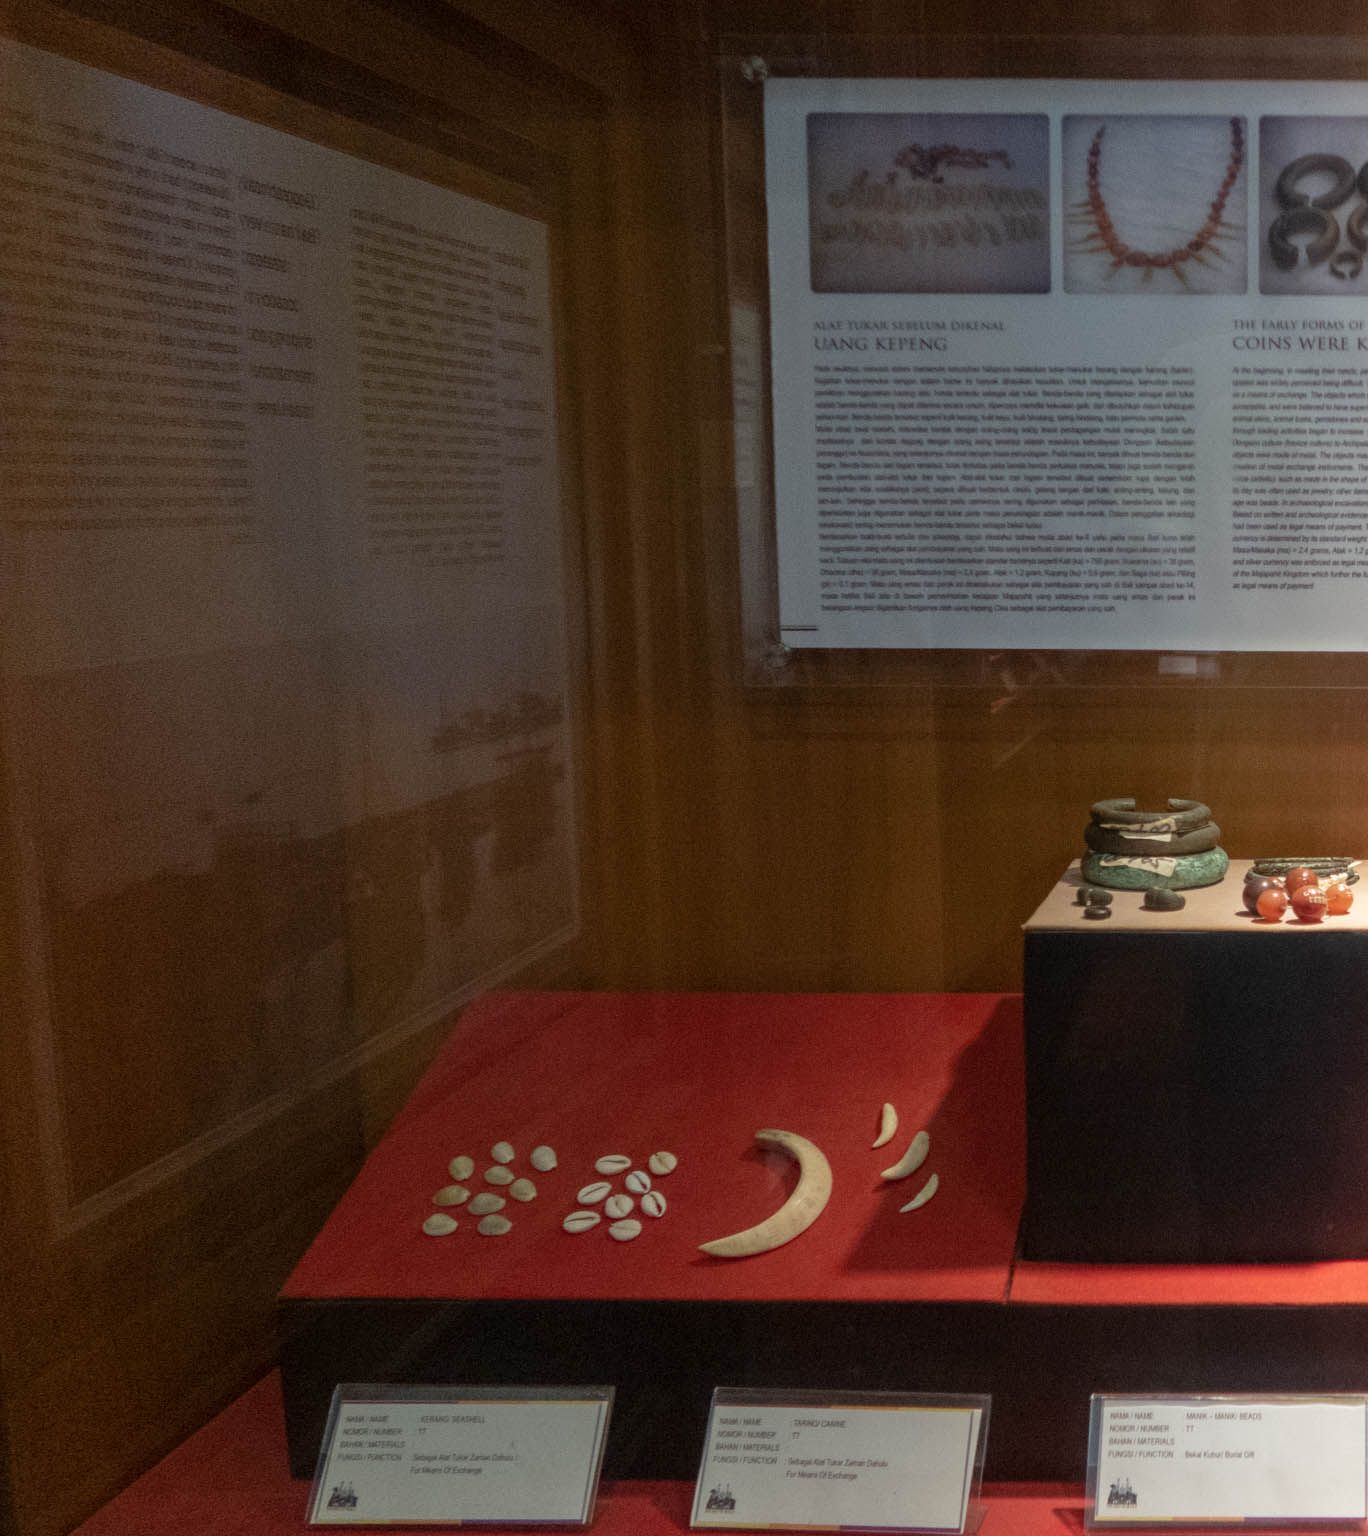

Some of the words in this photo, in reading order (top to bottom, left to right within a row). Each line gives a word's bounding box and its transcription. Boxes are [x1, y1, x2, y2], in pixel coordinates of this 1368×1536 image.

[1233, 320, 1256, 331] THE
[1262, 320, 1297, 331] EARLY
[1301, 320, 1344, 331] FORMS
[1349, 320, 1364, 331] OF
[814, 337, 867, 351] UANG
[876, 337, 948, 351] KEPENG
[1232, 336, 1291, 351] COINS
[1299, 336, 1349, 351] WERE
[1108, 1450, 1134, 1458] FUNGSI
[1138, 1450, 1174, 1458] FUNCTION
